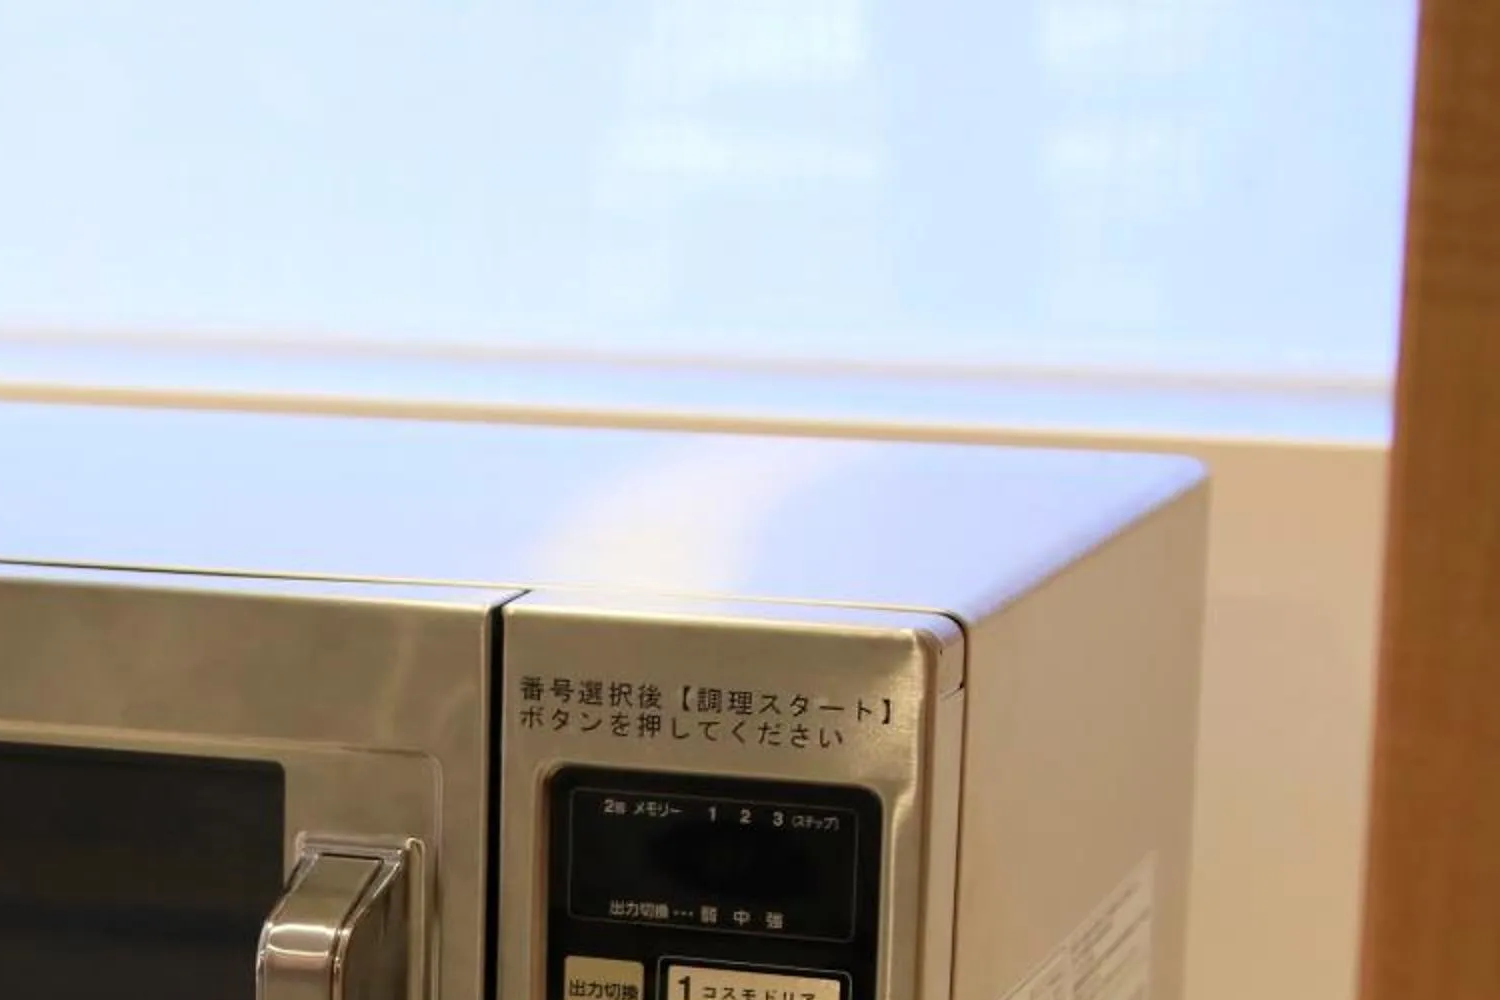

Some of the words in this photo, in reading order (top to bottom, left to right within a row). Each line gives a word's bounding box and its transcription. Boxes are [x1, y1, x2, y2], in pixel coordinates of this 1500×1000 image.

[519, 706, 844, 749] ボタンを押してください
[709, 807, 716, 822] 1
[740, 809, 751, 825] 2
[773, 811, 784, 828] 3
